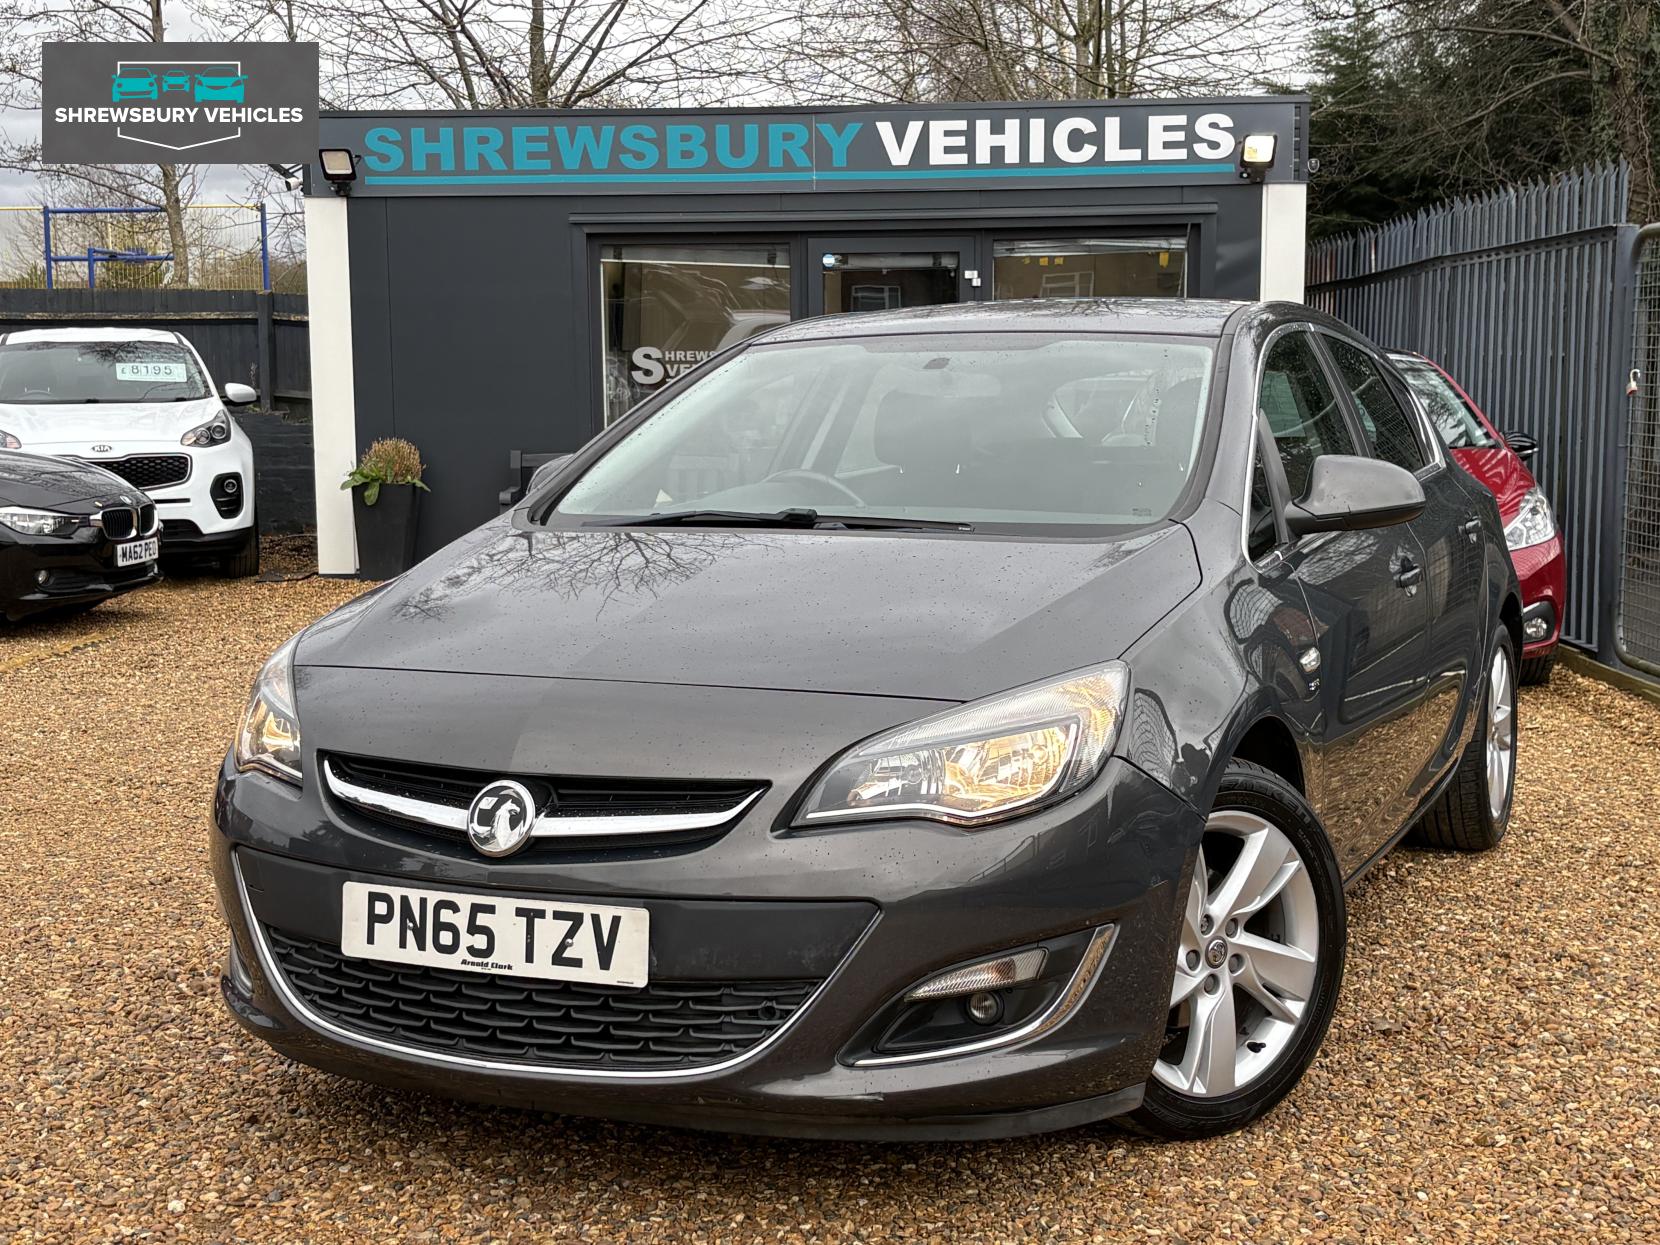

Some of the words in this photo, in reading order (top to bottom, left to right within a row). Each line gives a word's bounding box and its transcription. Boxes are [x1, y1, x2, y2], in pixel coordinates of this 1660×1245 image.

[363, 121, 864, 172] SHREWSBURY
[874, 112, 1236, 166] VEHICLES
[93, 445, 111, 453] KIA
[121, 543, 143, 563] MA62
[366, 890, 497, 960] PN65
[514, 906, 622, 971] TZV
[461, 958, 489, 968] Arnold
[490, 961, 513, 971] Clark
